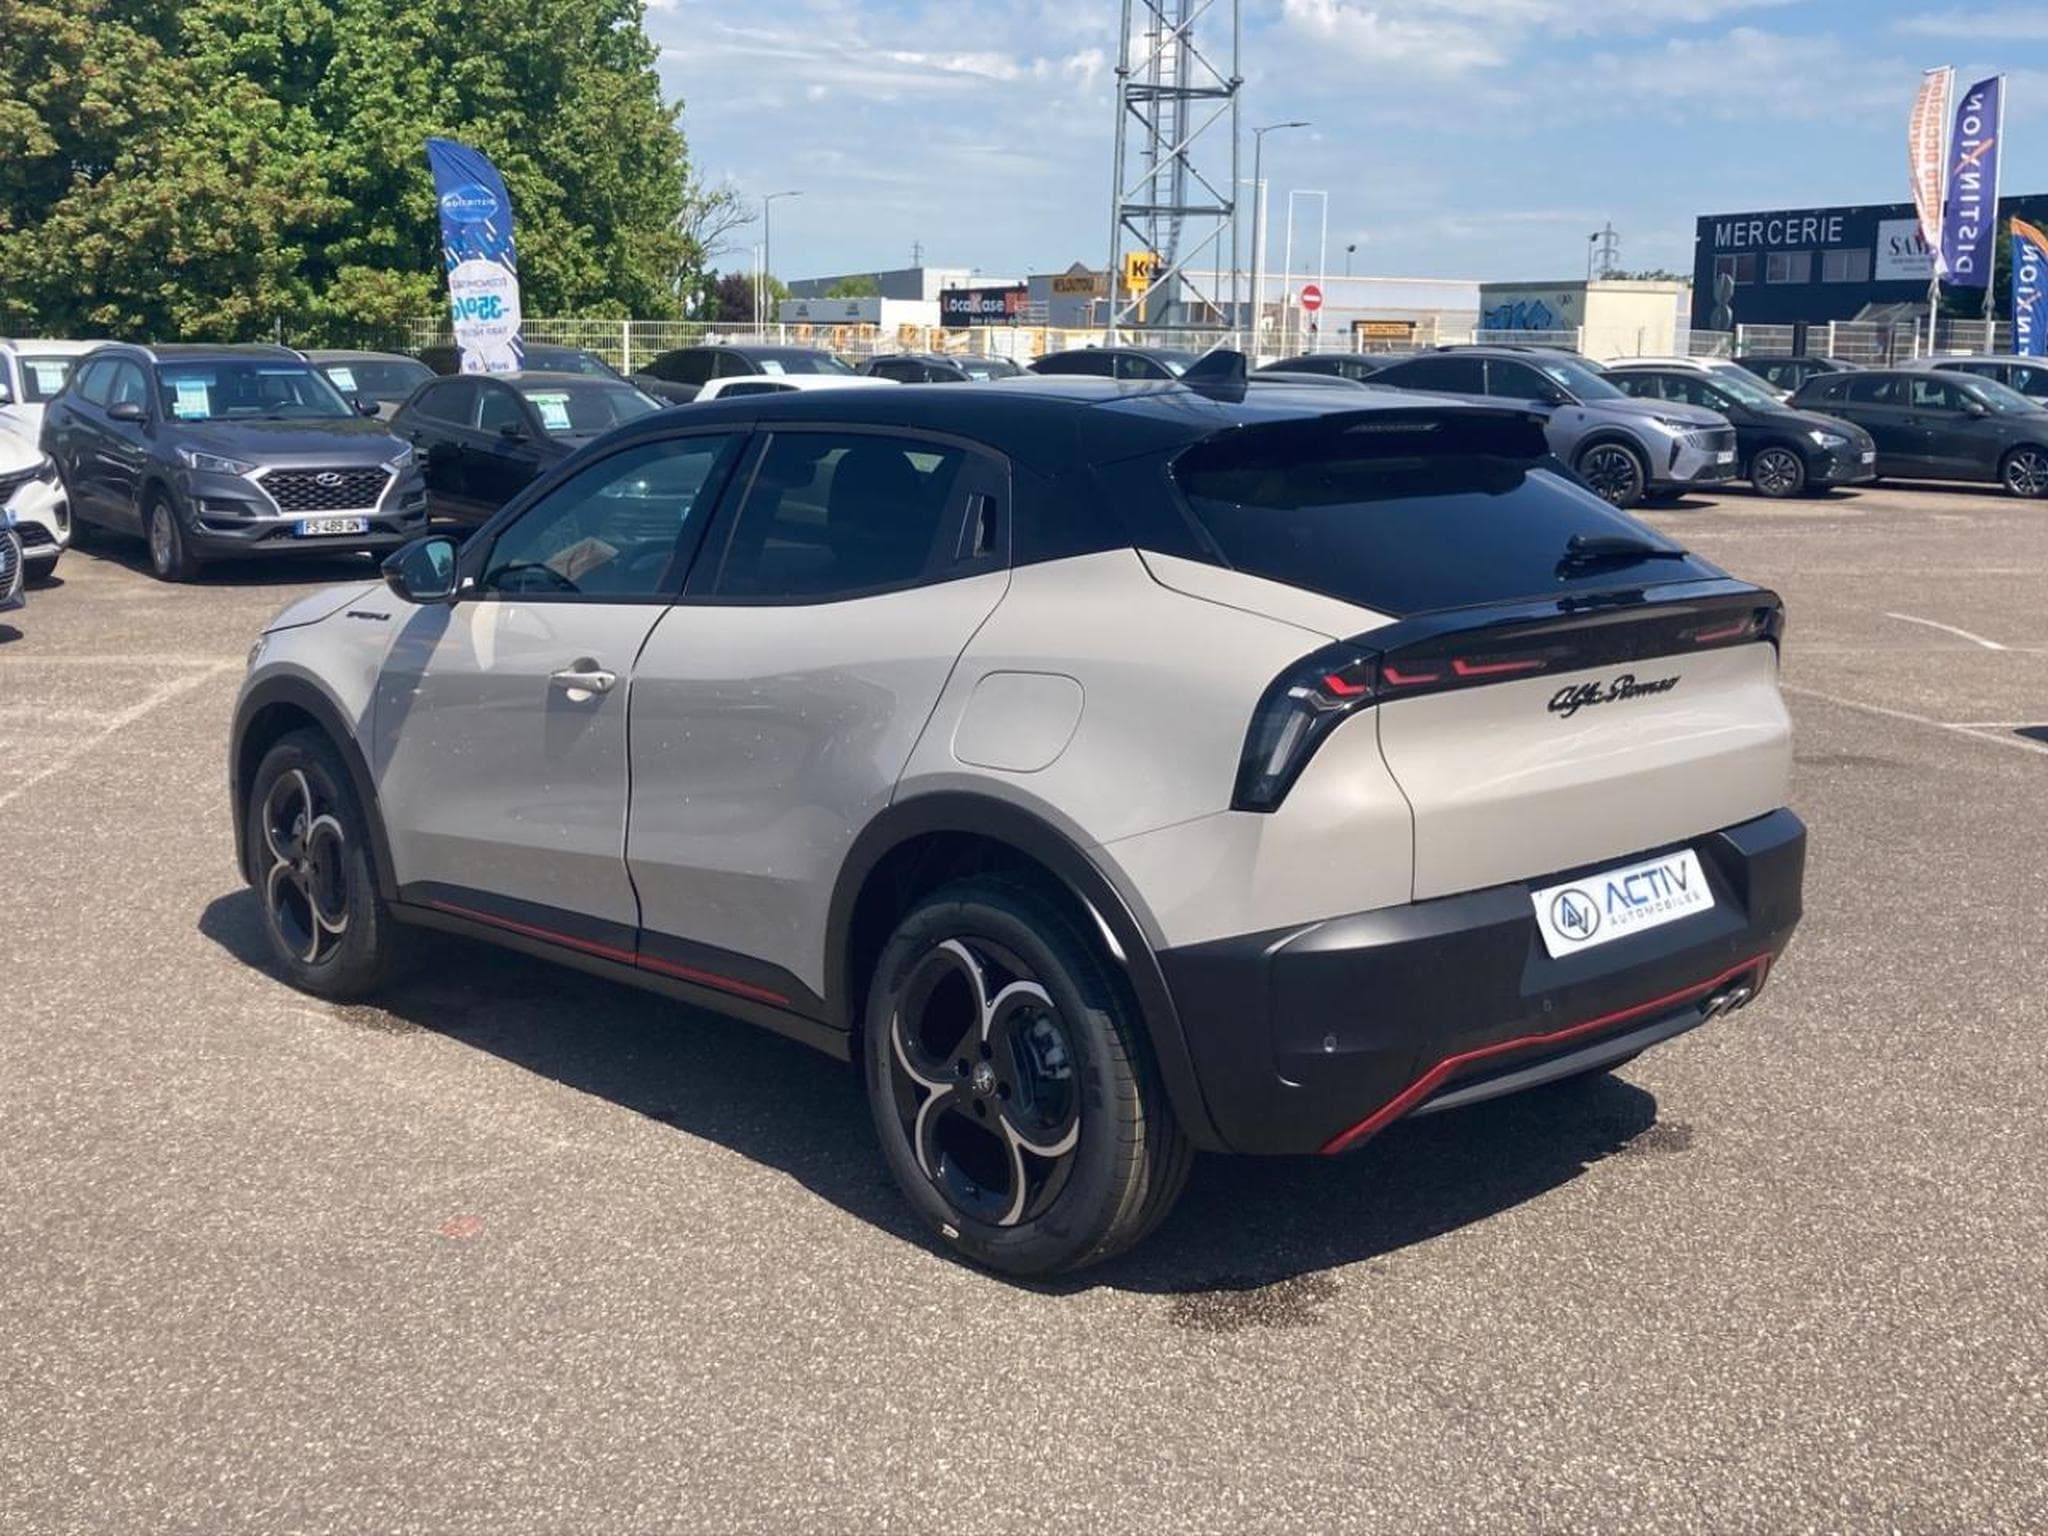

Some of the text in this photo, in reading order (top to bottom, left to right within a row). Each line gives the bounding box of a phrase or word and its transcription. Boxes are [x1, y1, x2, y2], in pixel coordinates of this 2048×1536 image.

[1715, 217, 1844, 248] MERCERIE
[1607, 861, 1688, 915] ACTIV
[1611, 892, 1702, 927] AUTOMOBILES
